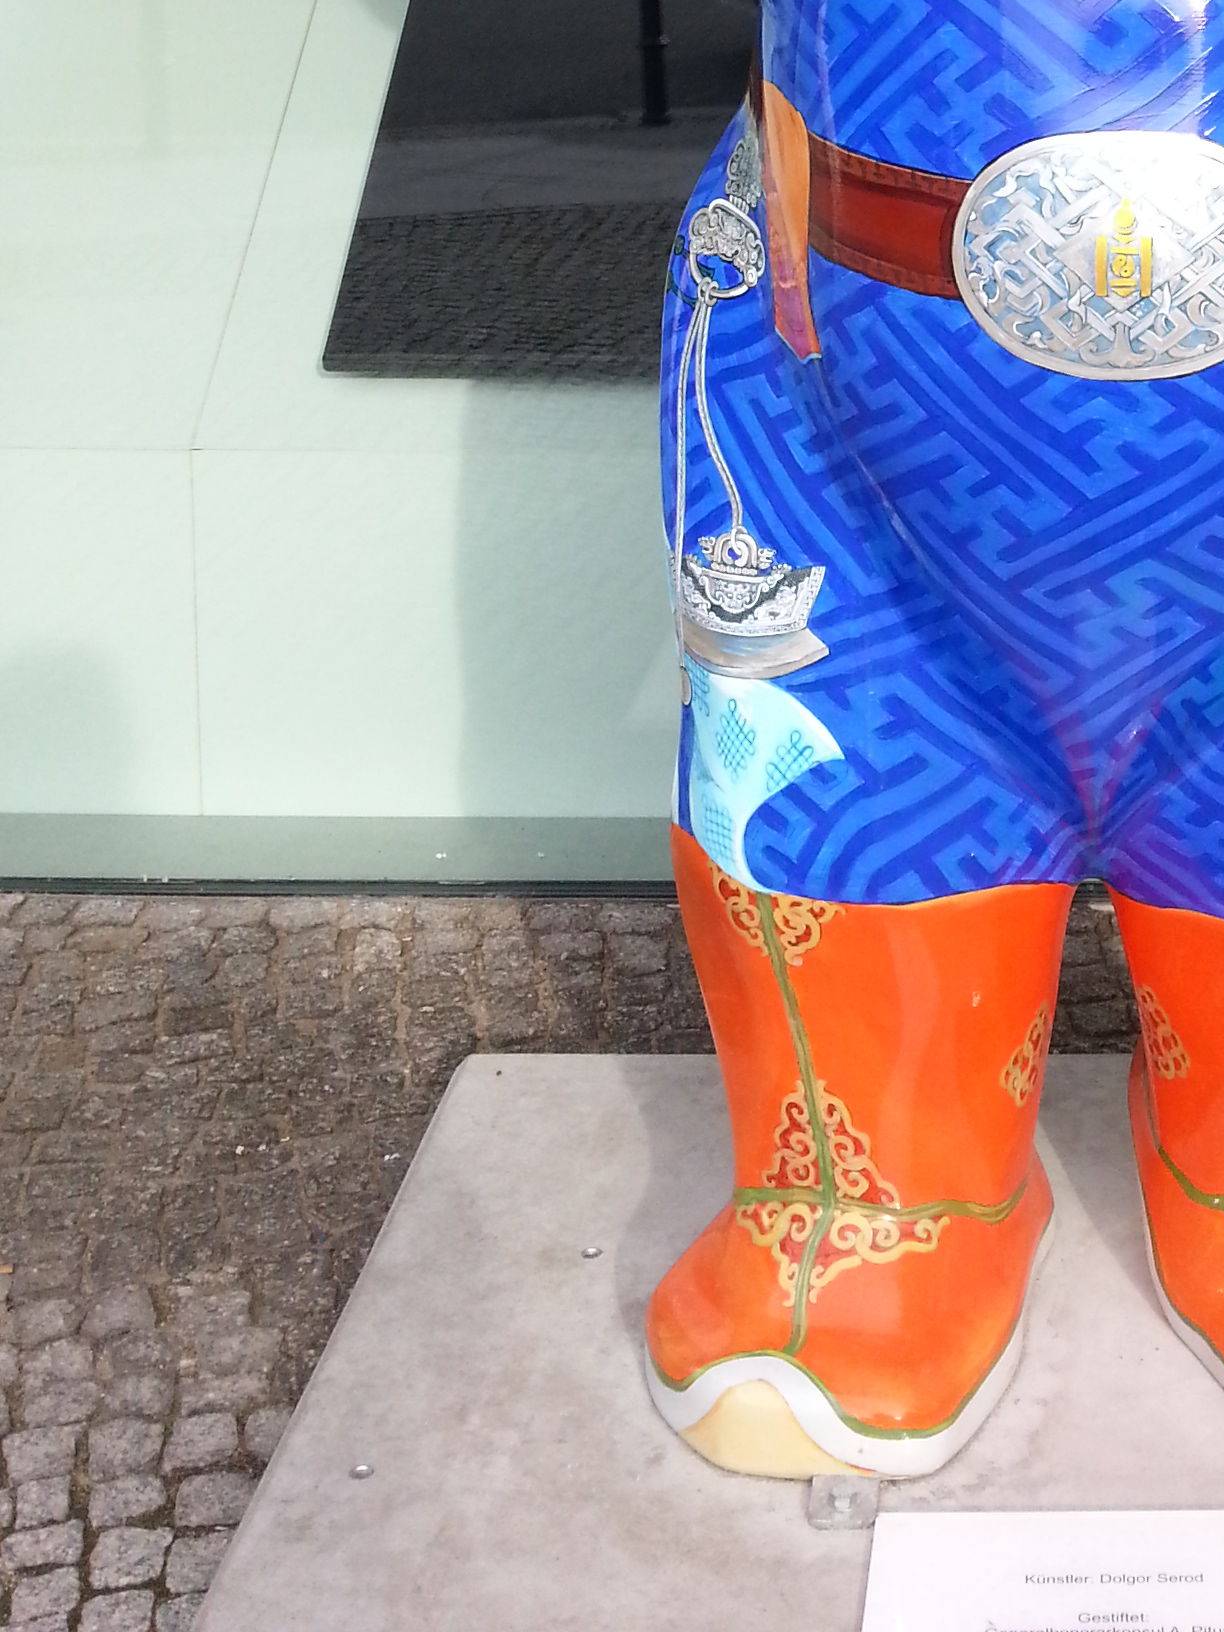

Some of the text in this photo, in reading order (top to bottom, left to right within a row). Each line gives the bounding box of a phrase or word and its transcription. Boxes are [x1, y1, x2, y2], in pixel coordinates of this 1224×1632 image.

[1024, 1572, 1205, 1586] Künstler: Dolgor Serod
